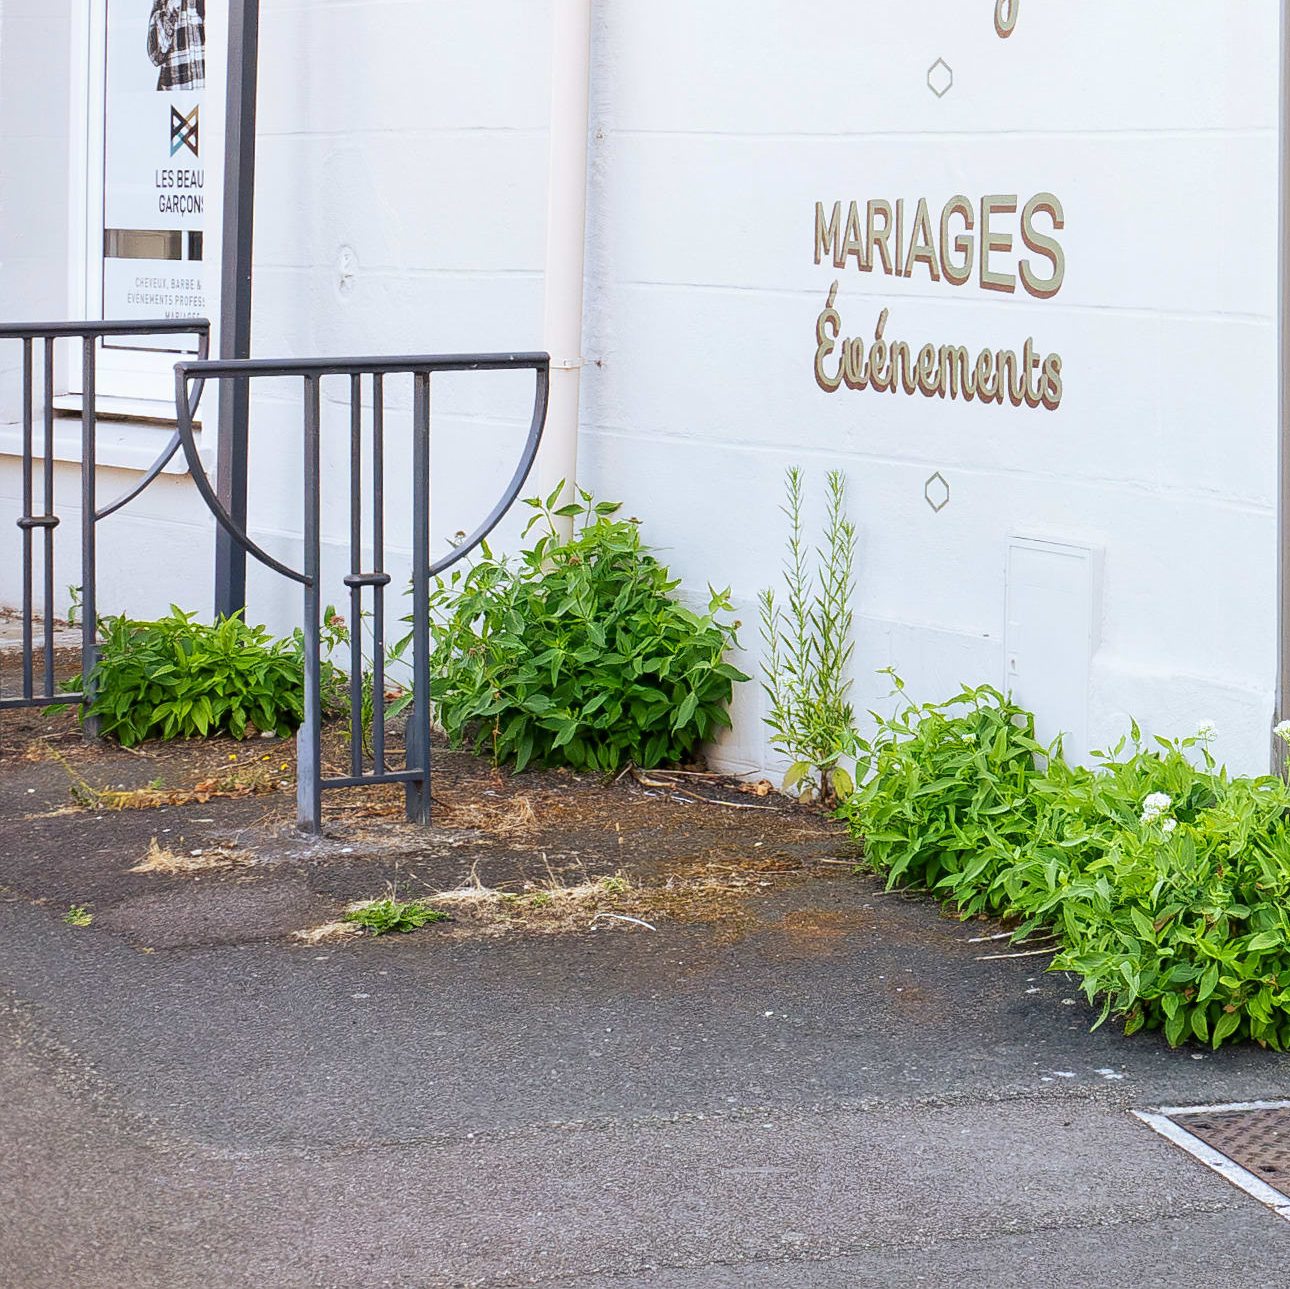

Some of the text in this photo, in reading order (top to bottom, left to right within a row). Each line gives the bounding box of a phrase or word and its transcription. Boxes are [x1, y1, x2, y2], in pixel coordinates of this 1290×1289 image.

[156, 169, 174, 188] LES
[813, 192, 1066, 299] MARIAGES
[814, 279, 1063, 411] Événements
